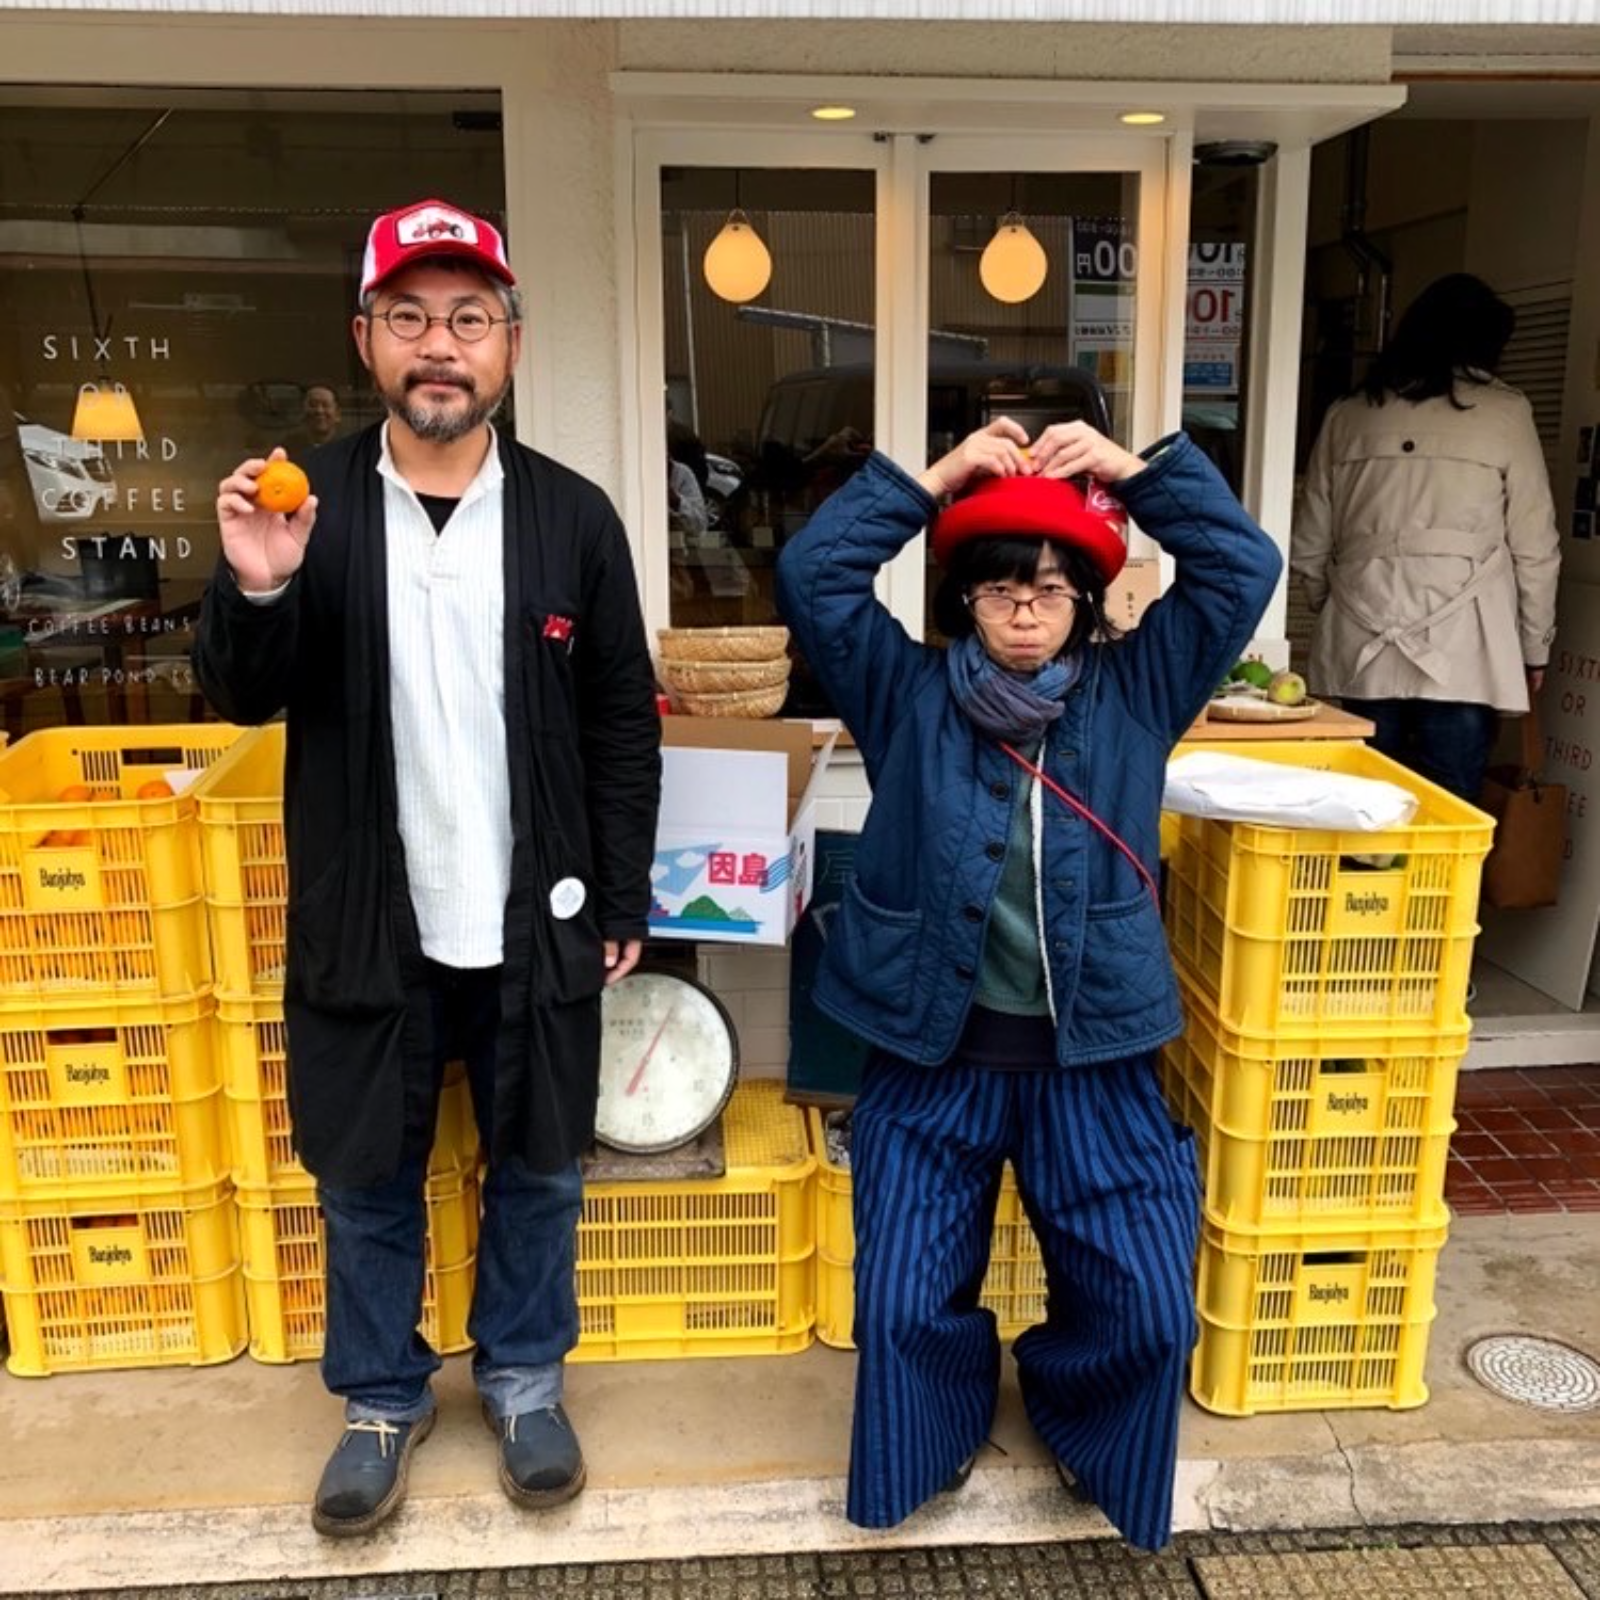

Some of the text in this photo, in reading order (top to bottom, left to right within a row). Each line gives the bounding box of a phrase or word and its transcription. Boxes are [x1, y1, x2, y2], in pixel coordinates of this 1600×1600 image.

[42, 336, 171, 361] SIXTH
[52, 437, 178, 461] THIRD
[41, 487, 186, 512] COFFEE
[61, 536, 192, 561] STAND
[28, 615, 191, 636] COFFEE BEANS
[34, 666, 90, 687] BEAR
[101, 667, 158, 685] POND
[1561, 691, 1587, 717] OR
[1545, 736, 1593, 771] THIRD
[708, 851, 770, 887] 因島
